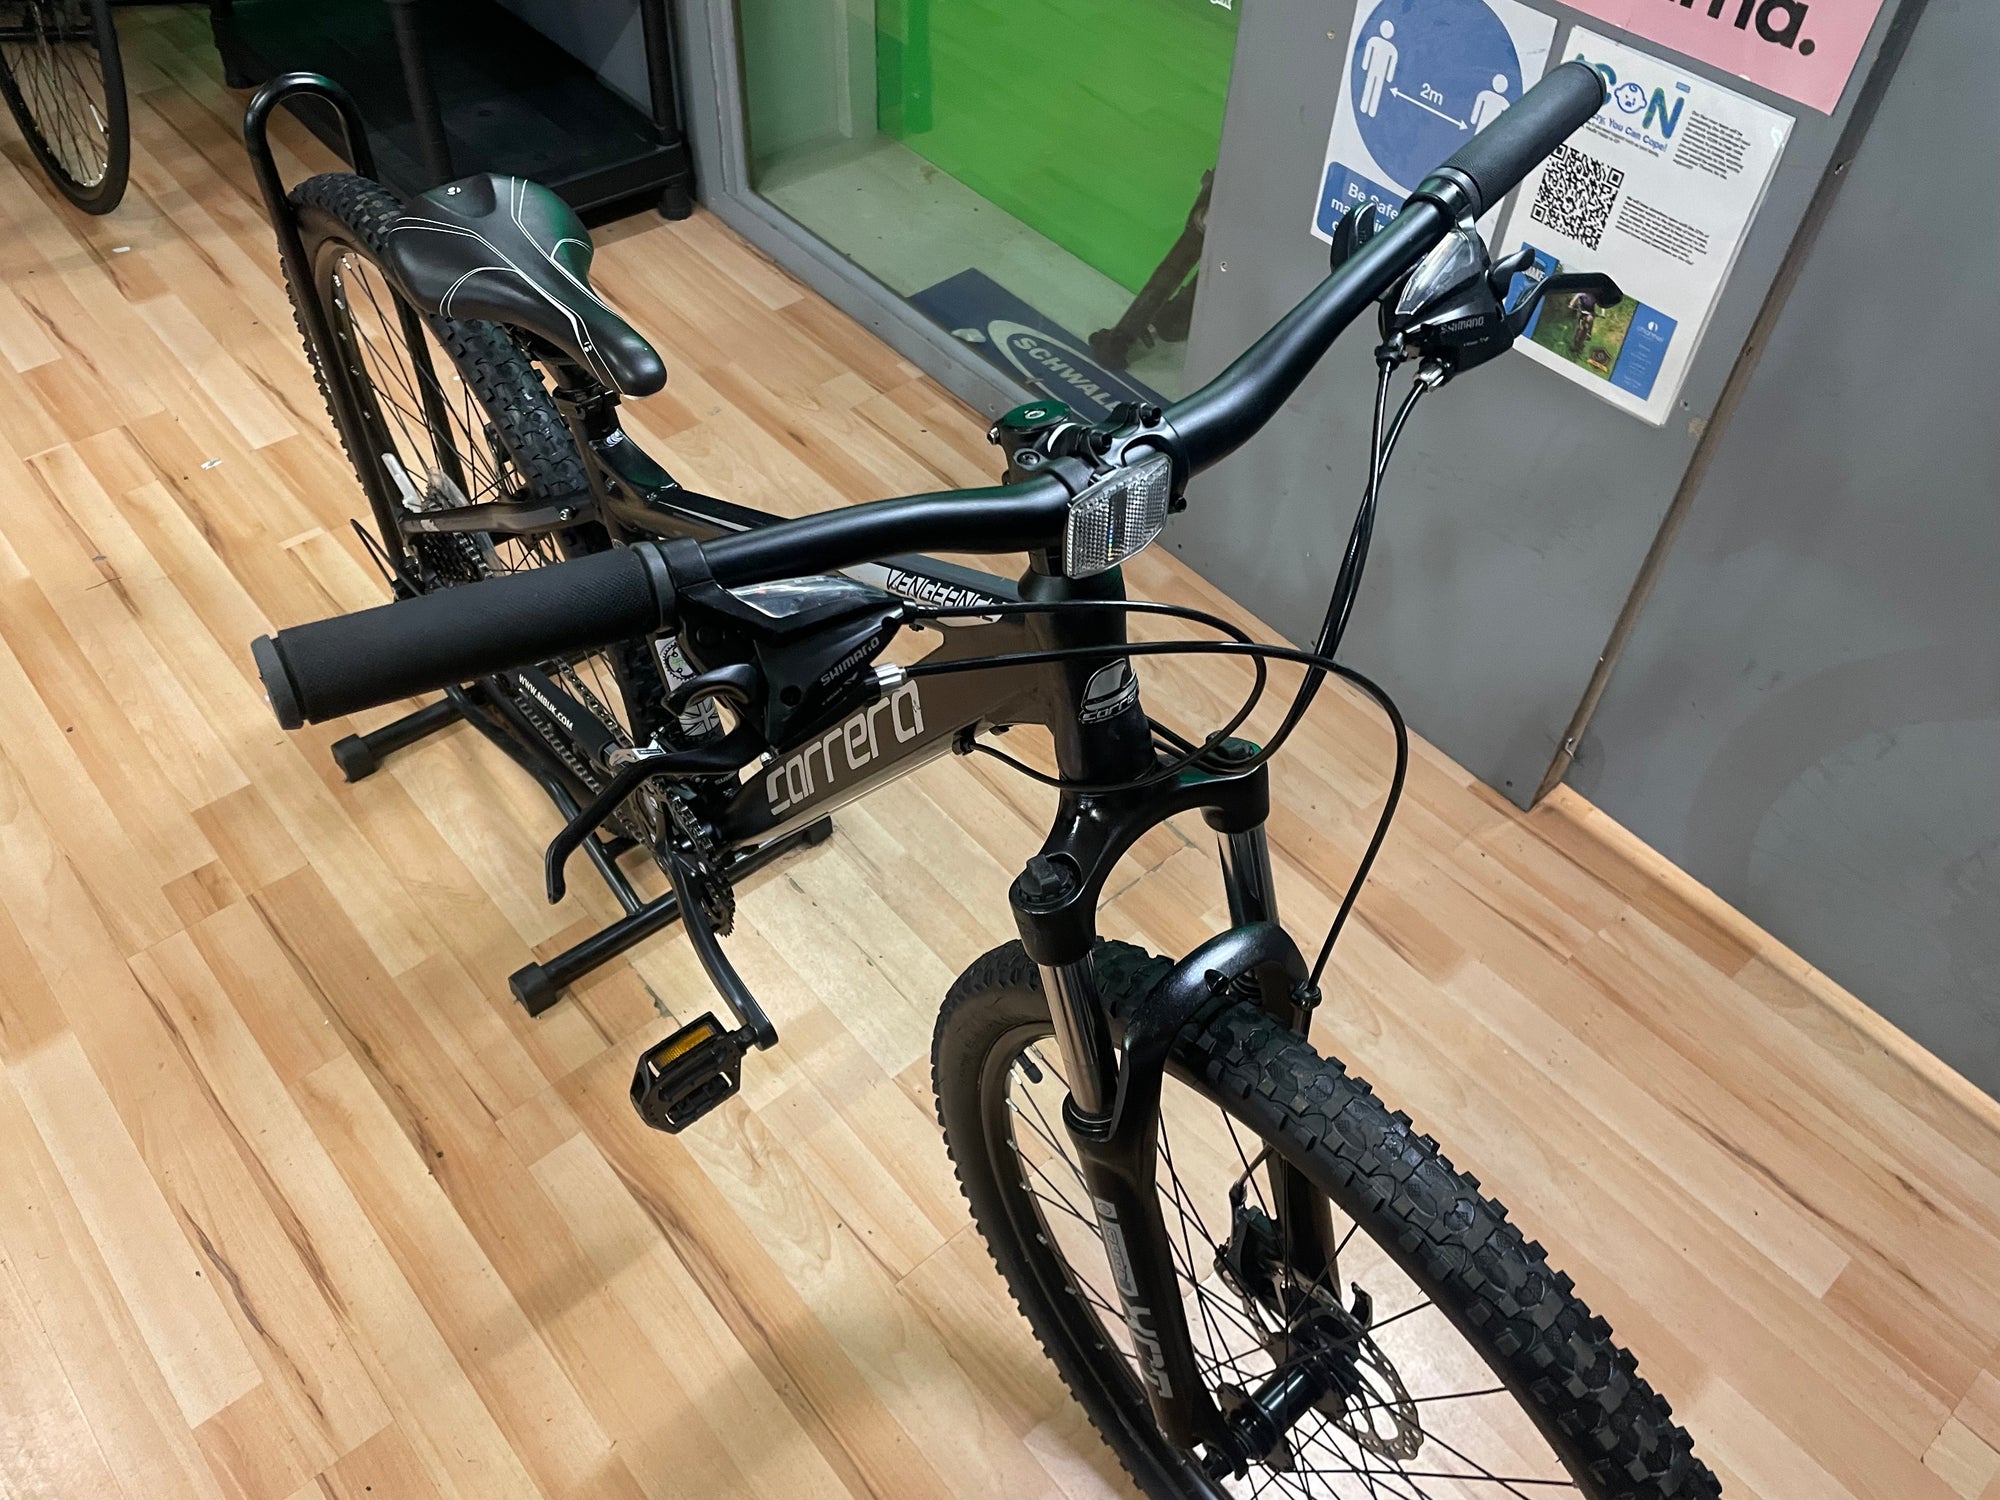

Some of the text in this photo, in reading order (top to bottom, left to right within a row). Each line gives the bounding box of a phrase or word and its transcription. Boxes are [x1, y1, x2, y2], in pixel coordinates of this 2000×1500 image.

[1419, 83, 1444, 106] 2m
[1348, 182, 1366, 202] Be
[886, 567, 1002, 622] VENGEAN
[519, 673, 573, 731] WWW.MBUK.COM
[1082, 687, 1137, 721] carre
